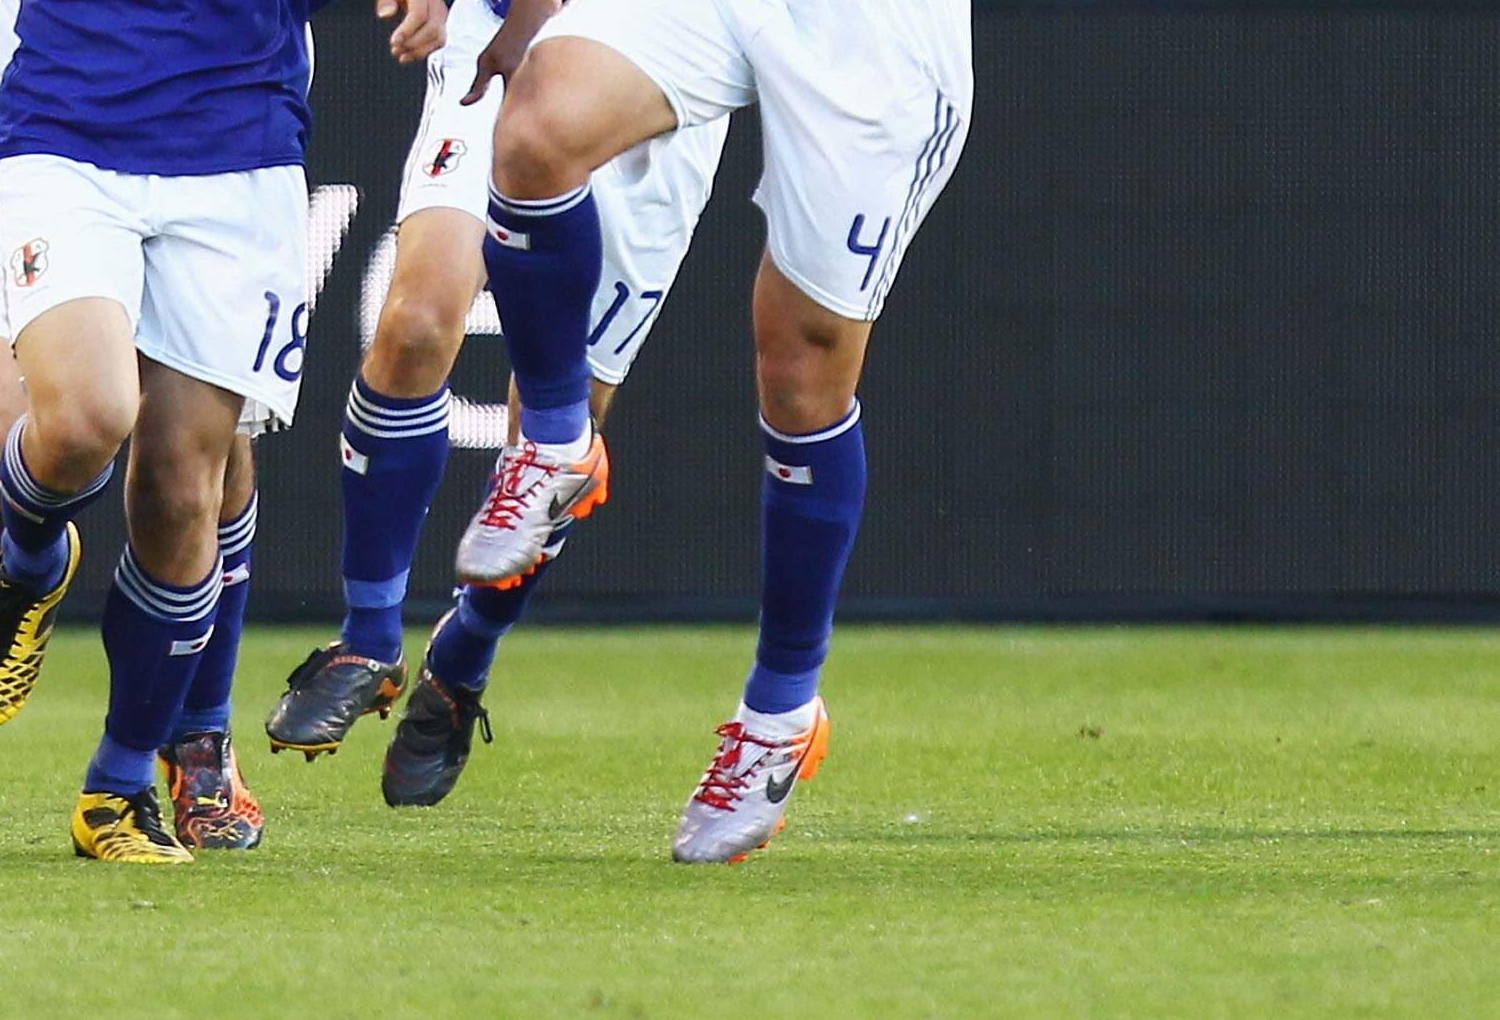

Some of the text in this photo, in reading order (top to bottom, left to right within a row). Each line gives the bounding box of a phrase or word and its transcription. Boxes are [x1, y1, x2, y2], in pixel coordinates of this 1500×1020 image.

[847, 213, 891, 292] 4
[252, 290, 306, 382] 18
[587, 281, 664, 354] 17
